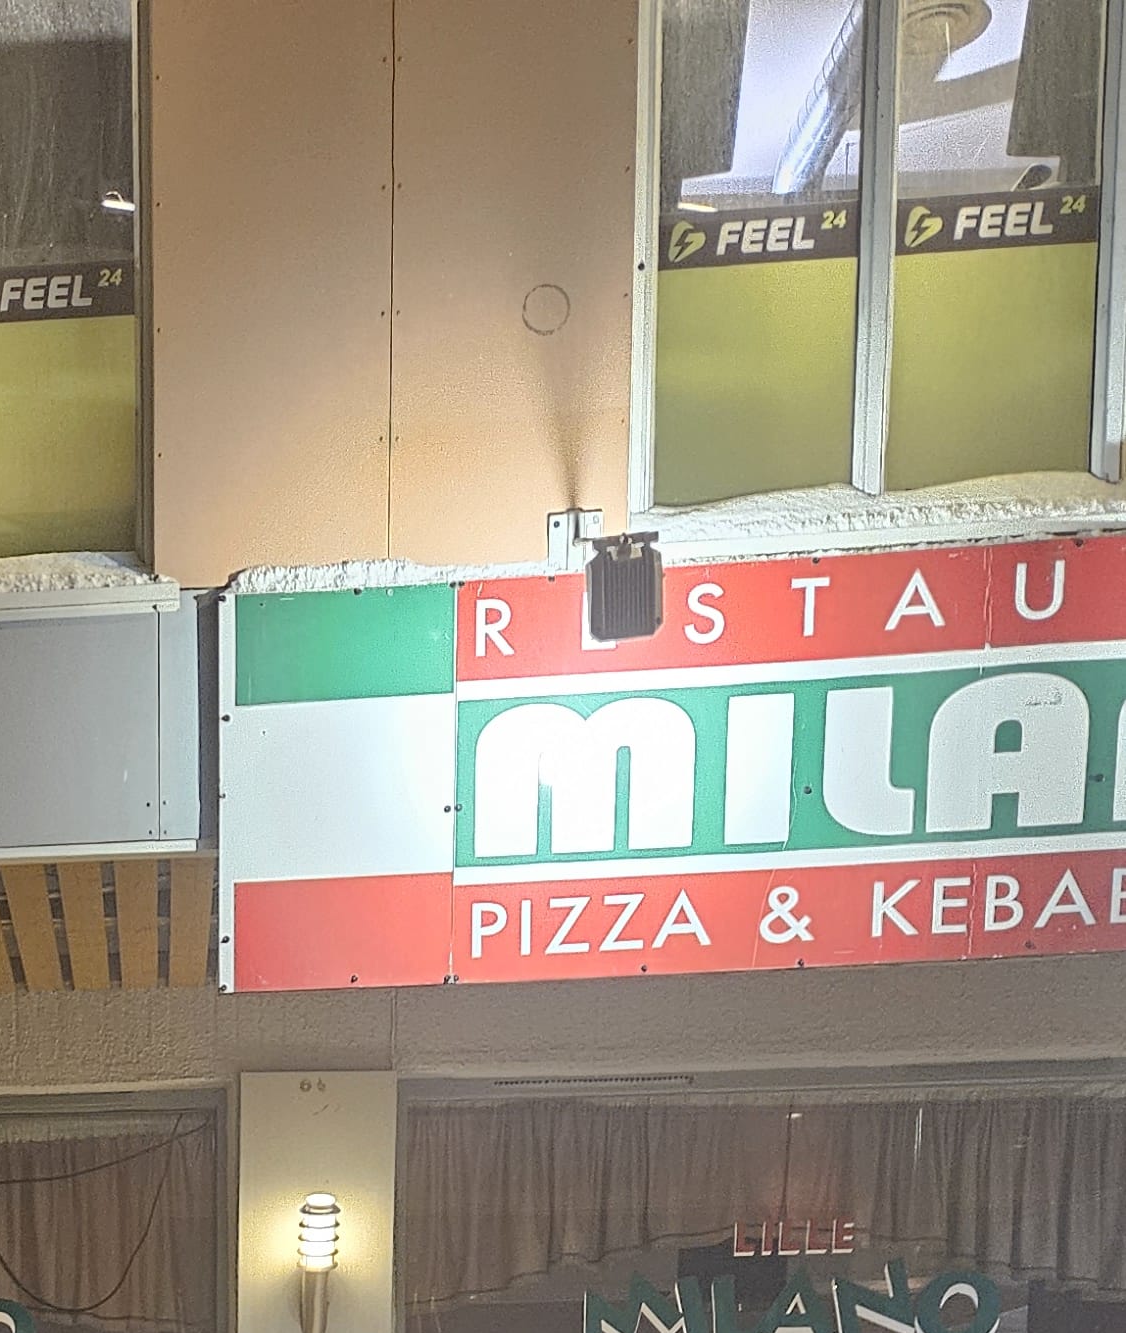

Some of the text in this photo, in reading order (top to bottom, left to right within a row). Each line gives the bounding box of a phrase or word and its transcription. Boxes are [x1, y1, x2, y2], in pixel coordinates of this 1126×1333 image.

[715, 210, 846, 256] FEEL 24
[954, 195, 1086, 241] FEEL 24
[0, 268, 123, 313] FEEL 24
[474, 671, 1126, 858] MILA
[470, 889, 712, 958] PIZZA
[758, 885, 814, 944] &
[733, 1218, 855, 1257] LILLE
